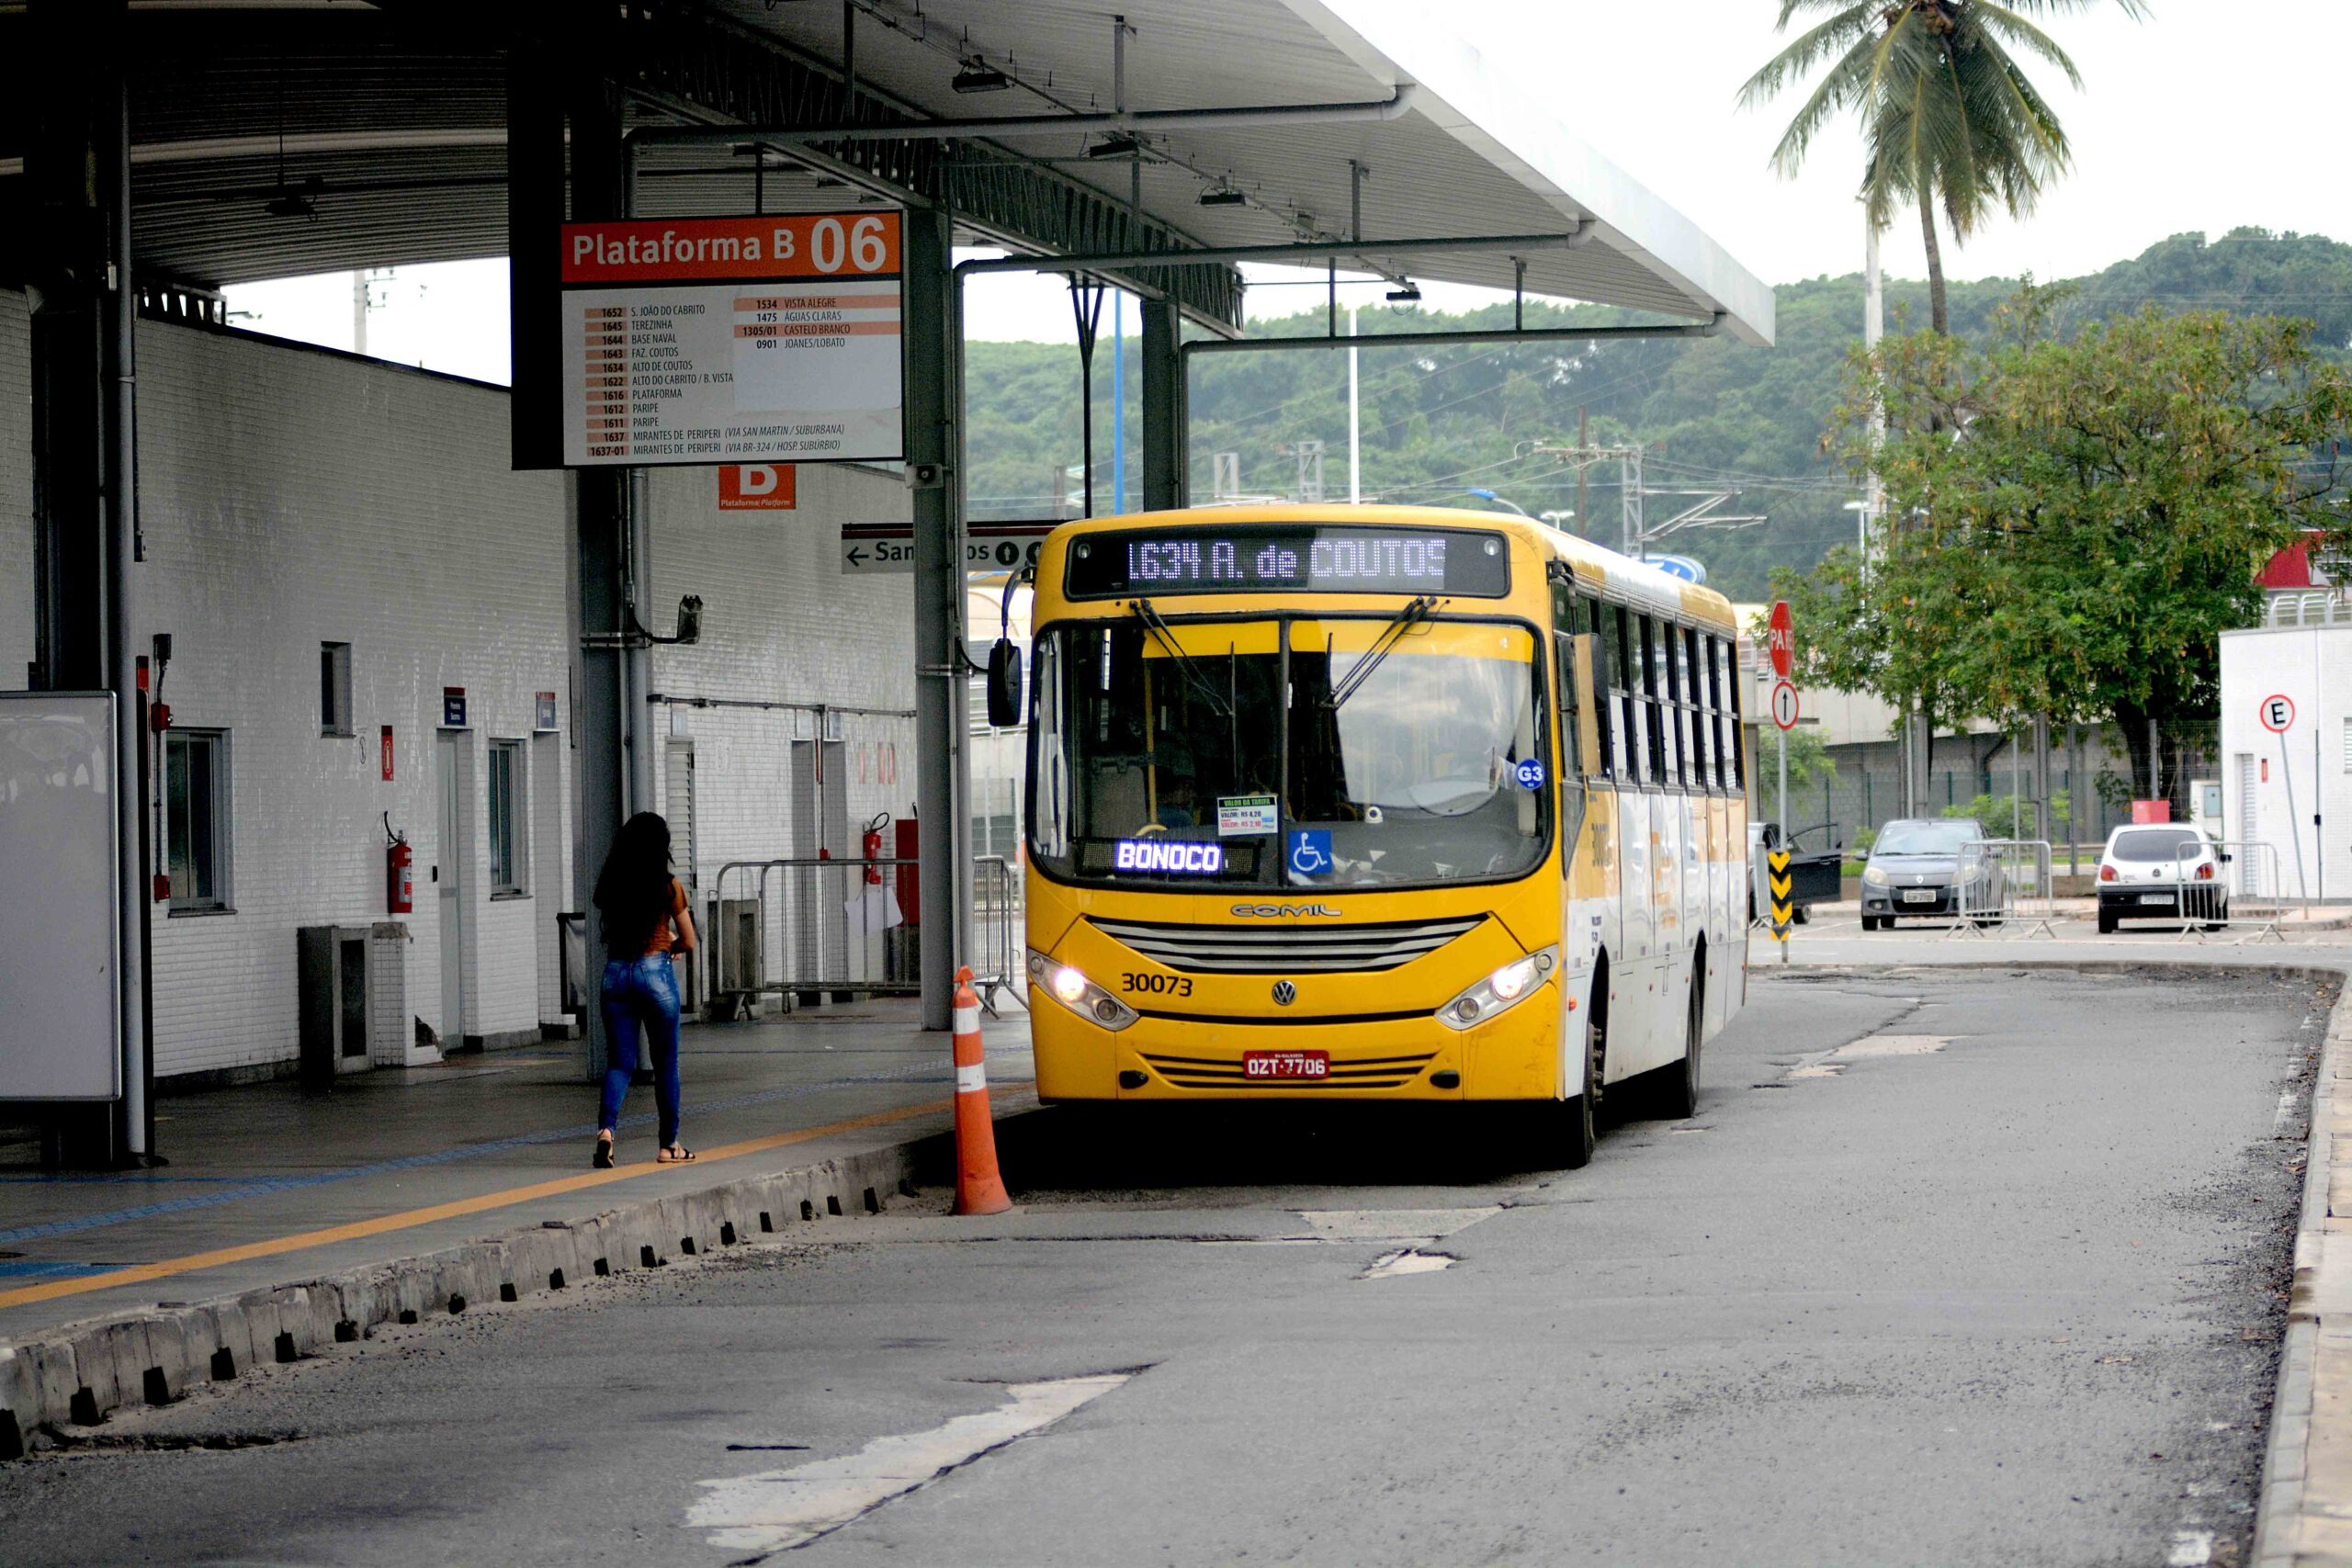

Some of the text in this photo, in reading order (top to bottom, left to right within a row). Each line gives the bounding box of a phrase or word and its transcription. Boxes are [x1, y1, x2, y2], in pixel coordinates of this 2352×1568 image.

[573, 217, 887, 273] Plataforma B 06
[757, 298, 836, 309] 1534 VISTA ALEGRE
[603, 305, 705, 317] 1652 S. JOÃO DO CABRITO
[757, 310, 841, 321] 1475 ÁGUAS CLARAS
[603, 321, 673, 331] 1645 TEREZINHA
[743, 324, 850, 336] 1305/01 CASTELO BRANCO
[603, 333, 676, 344] 1644 BASE NAVAL
[757, 338, 844, 349] 0901 JOANES/LOBATO
[603, 347, 678, 358] 1643 FAZ. COUTOS
[603, 361, 693, 372] 1634 ALTO DE COUTOS
[603, 378, 623, 387] 1622
[632, 377, 650, 386] ALTO
[652, 376, 662, 385] DO
[665, 374, 696, 385] CABRITO
[704, 374, 710, 383] B.
[713, 373, 733, 383] VISTA
[603, 389, 682, 400] 1616 PLATAFORMA
[604, 403, 659, 413] 1612 PARIPE
[604, 417, 659, 427] 1611 PARIPE
[605, 433, 625, 442] 1637
[634, 431, 672, 441] MIRANTES
[674, 430, 684, 439] DE
[687, 429, 720, 439] PERIPERI
[725, 428, 741, 438] (VIA
[742, 427, 757, 436] SAN
[759, 425, 788, 436] MARTIN
[795, 423, 844, 435] SUBURBANA)
[591, 446, 625, 456] 1637-01
[634, 445, 672, 455] MIRANTES
[674, 444, 684, 454] DE
[688, 443, 720, 453] PERIPERI
[725, 443, 741, 454] (VIA
[742, 442, 770, 452] BR-324
[799, 438, 841, 451] SUBÚRBIO)
[1213, 543, 1243, 579] A.
[1257, 545, 1297, 578] de
[1310, 540, 1446, 577] COUTOS
[2271, 703, 2286, 725] E
[1518, 766, 1543, 782] G3
[1117, 842, 1221, 871] BONOCO
[1231, 904, 1342, 917] COMIL
[1122, 973, 1193, 997] 30073
